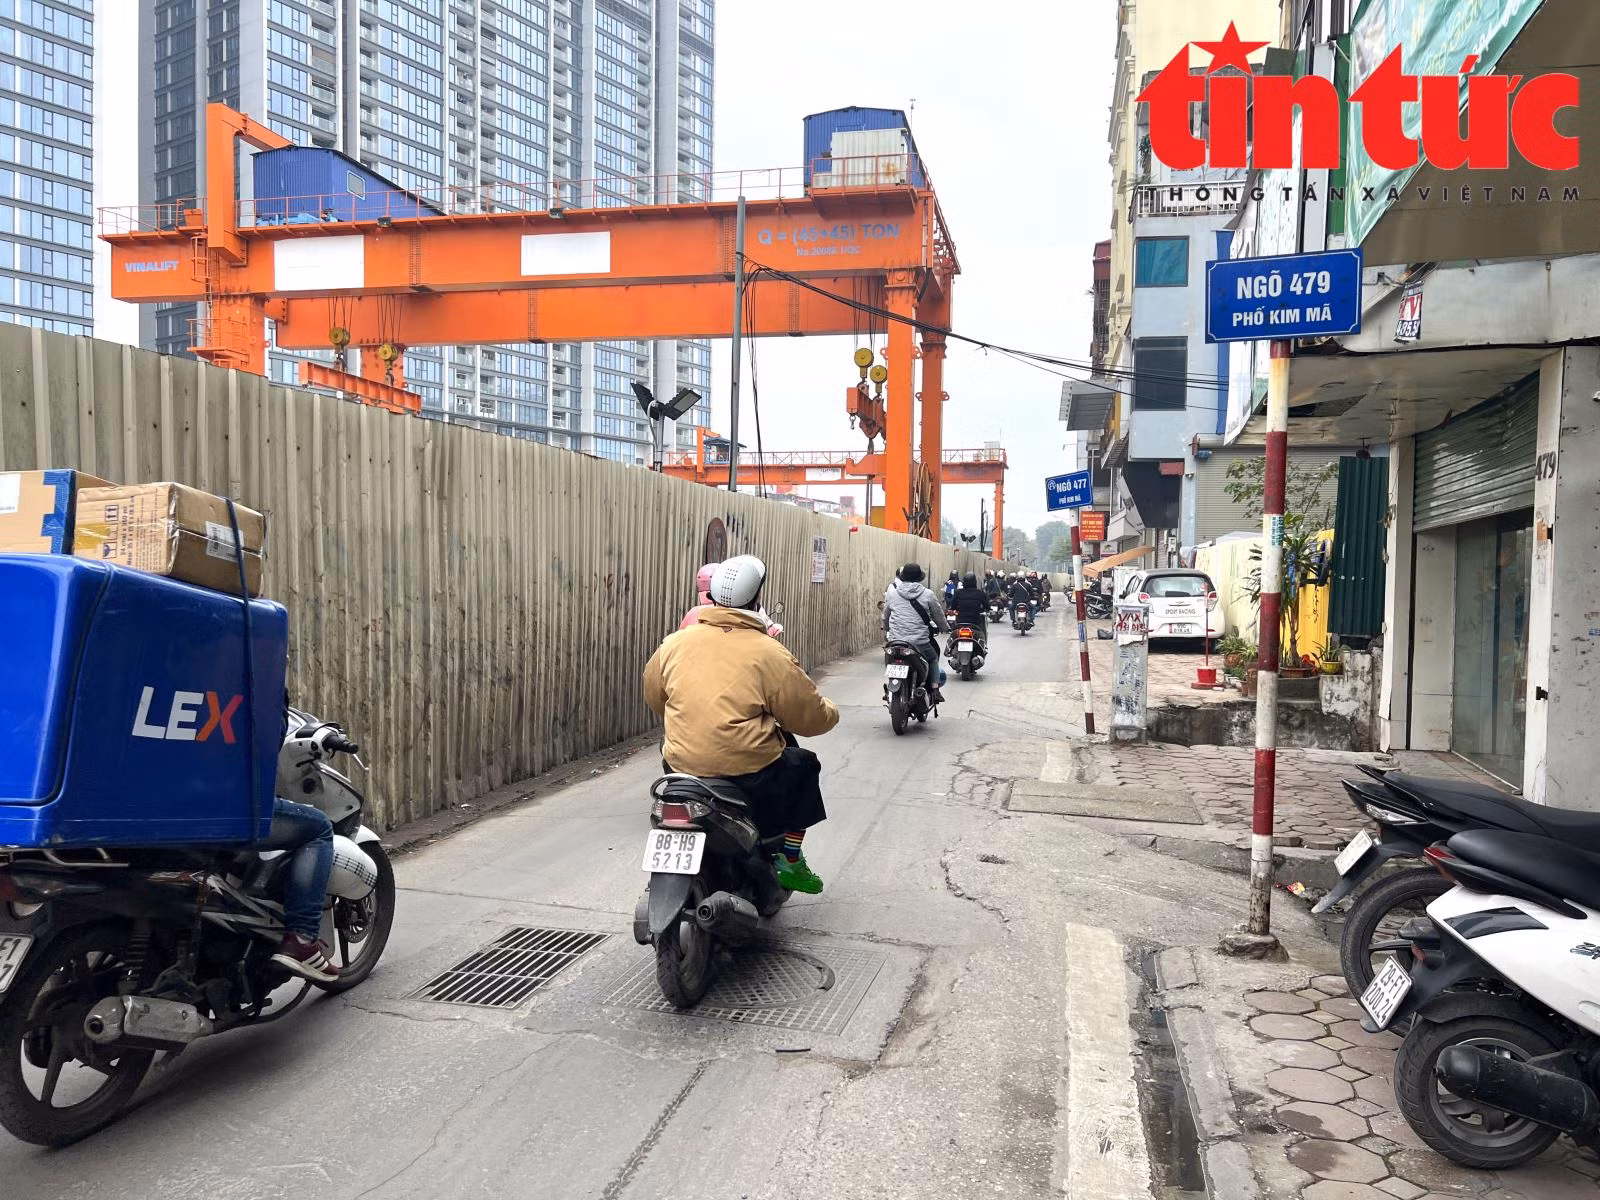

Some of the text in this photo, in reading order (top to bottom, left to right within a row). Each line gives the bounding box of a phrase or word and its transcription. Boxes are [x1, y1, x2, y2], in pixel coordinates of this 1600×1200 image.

[758, 228, 772, 245] Q
[862, 223, 899, 239] TON
[124, 260, 179, 273] VINALIFT
[1236, 269, 1331, 300] NGÕ 479
[1232, 303, 1332, 327] PHỐ KIM MÃ
[1535, 451, 1557, 481] 479
[1056, 478, 1087, 493] NGÕ 477
[131, 685, 245, 744] LEX
[655, 833, 696, 852] 88-H9
[651, 851, 693, 871] 5213
[1380, 963, 1406, 999] 29-F1
[1364, 982, 1393, 1025] 200.24
